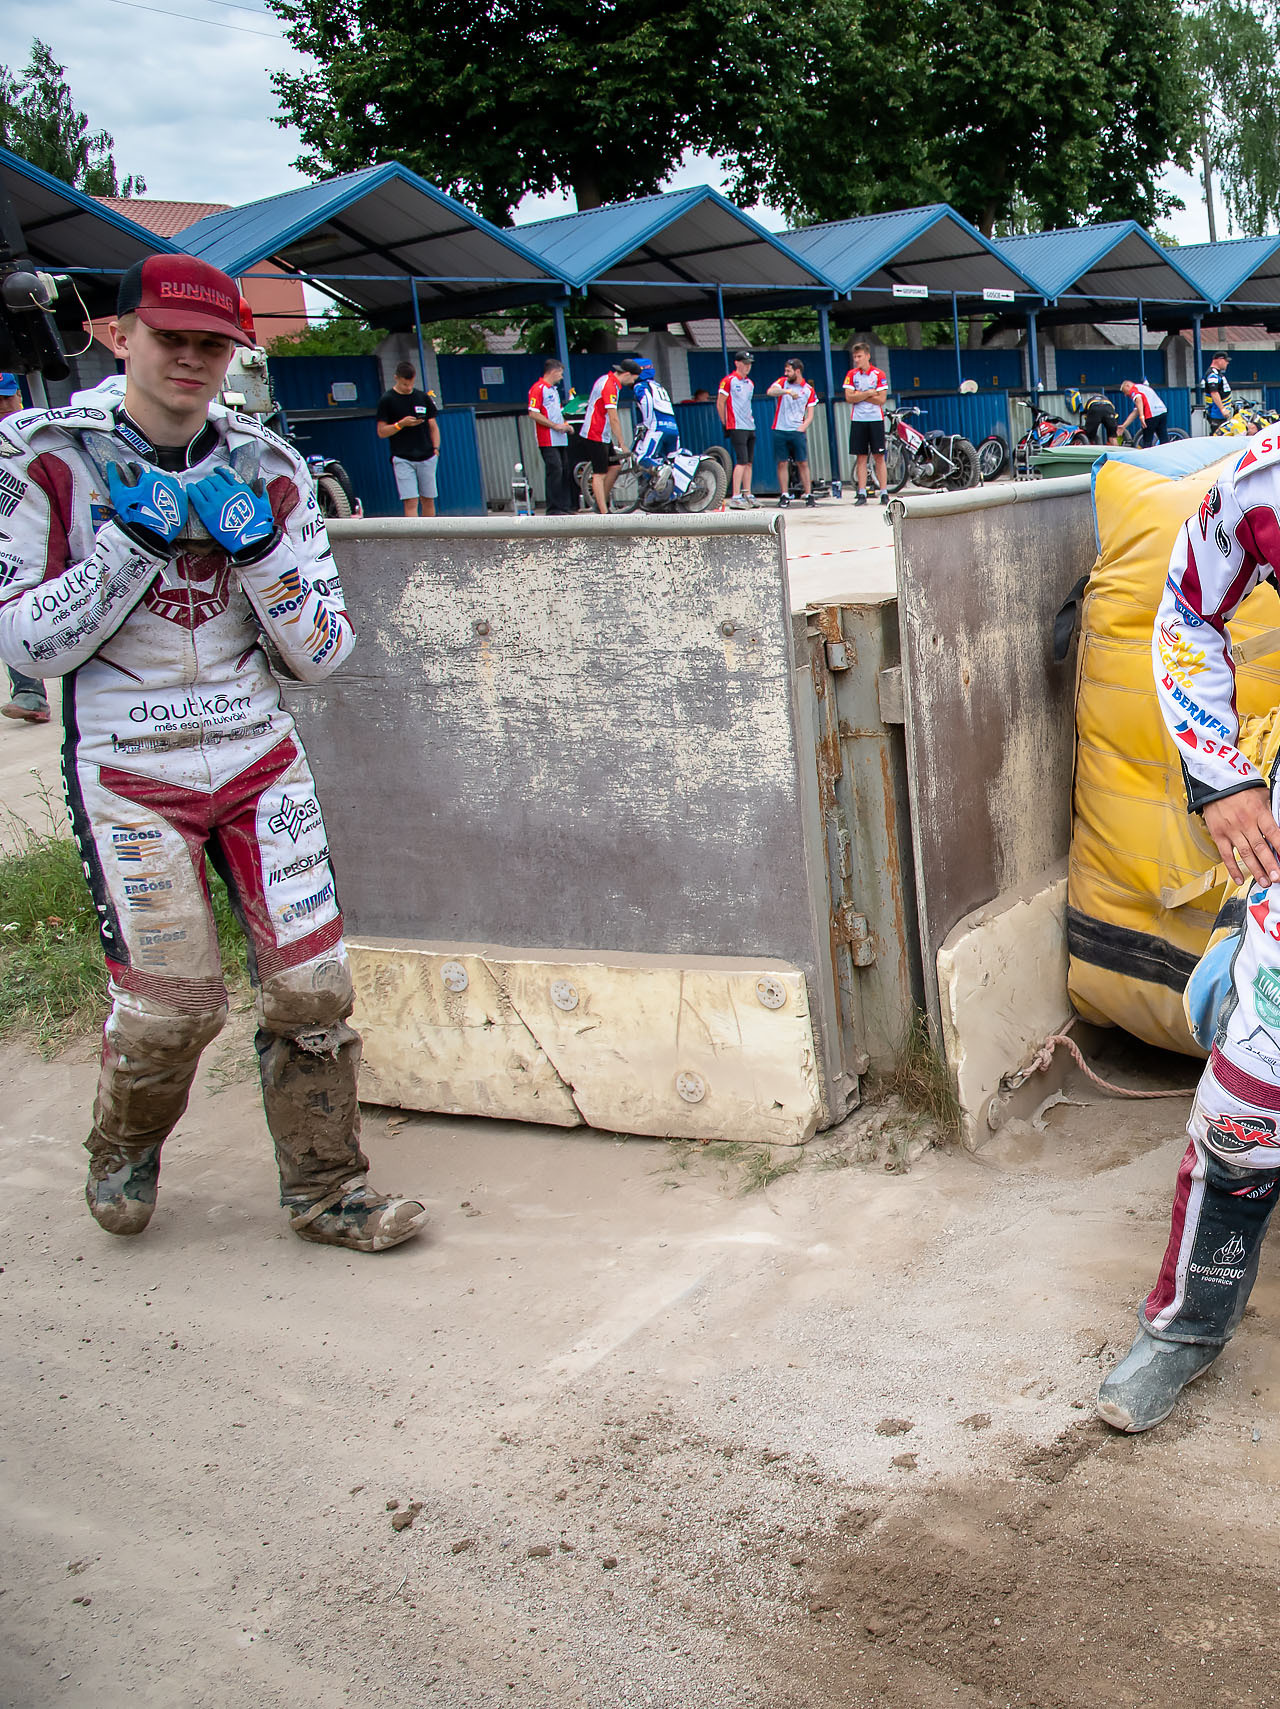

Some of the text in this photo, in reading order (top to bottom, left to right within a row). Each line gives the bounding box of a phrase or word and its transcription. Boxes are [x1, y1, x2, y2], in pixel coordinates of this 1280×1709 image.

[159, 281, 234, 315] RUNNING
[312, 609, 337, 665] ERGOSS
[154, 722, 177, 732] mēs
[1202, 739, 1252, 776] SELS
[268, 795, 319, 842] EVOR
[112, 829, 163, 843] ERGOSS
[125, 880, 173, 895] ERGOSS
[140, 930, 187, 946] ERGOSS
[1201, 1275, 1233, 1286] FOODTRUCK
